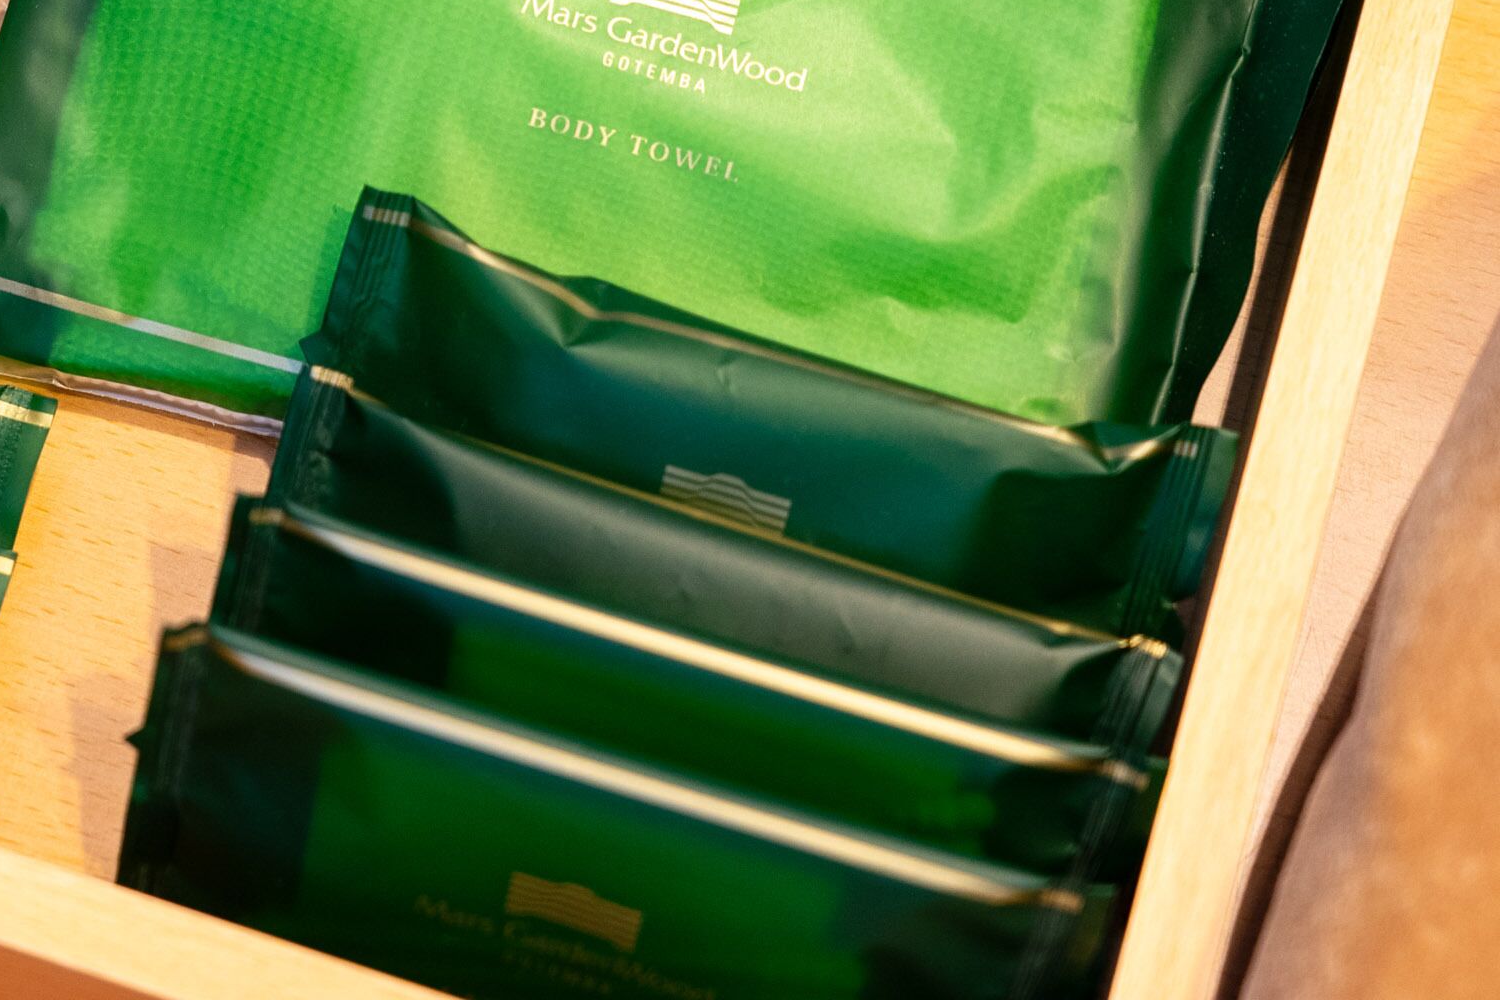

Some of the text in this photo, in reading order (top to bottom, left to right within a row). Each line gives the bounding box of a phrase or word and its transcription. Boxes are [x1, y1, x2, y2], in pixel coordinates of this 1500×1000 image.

[601, 50, 707, 94] GOTEMBA
[606, 15, 809, 93] GardenWood
[527, 106, 740, 183] BODY TOWEL
